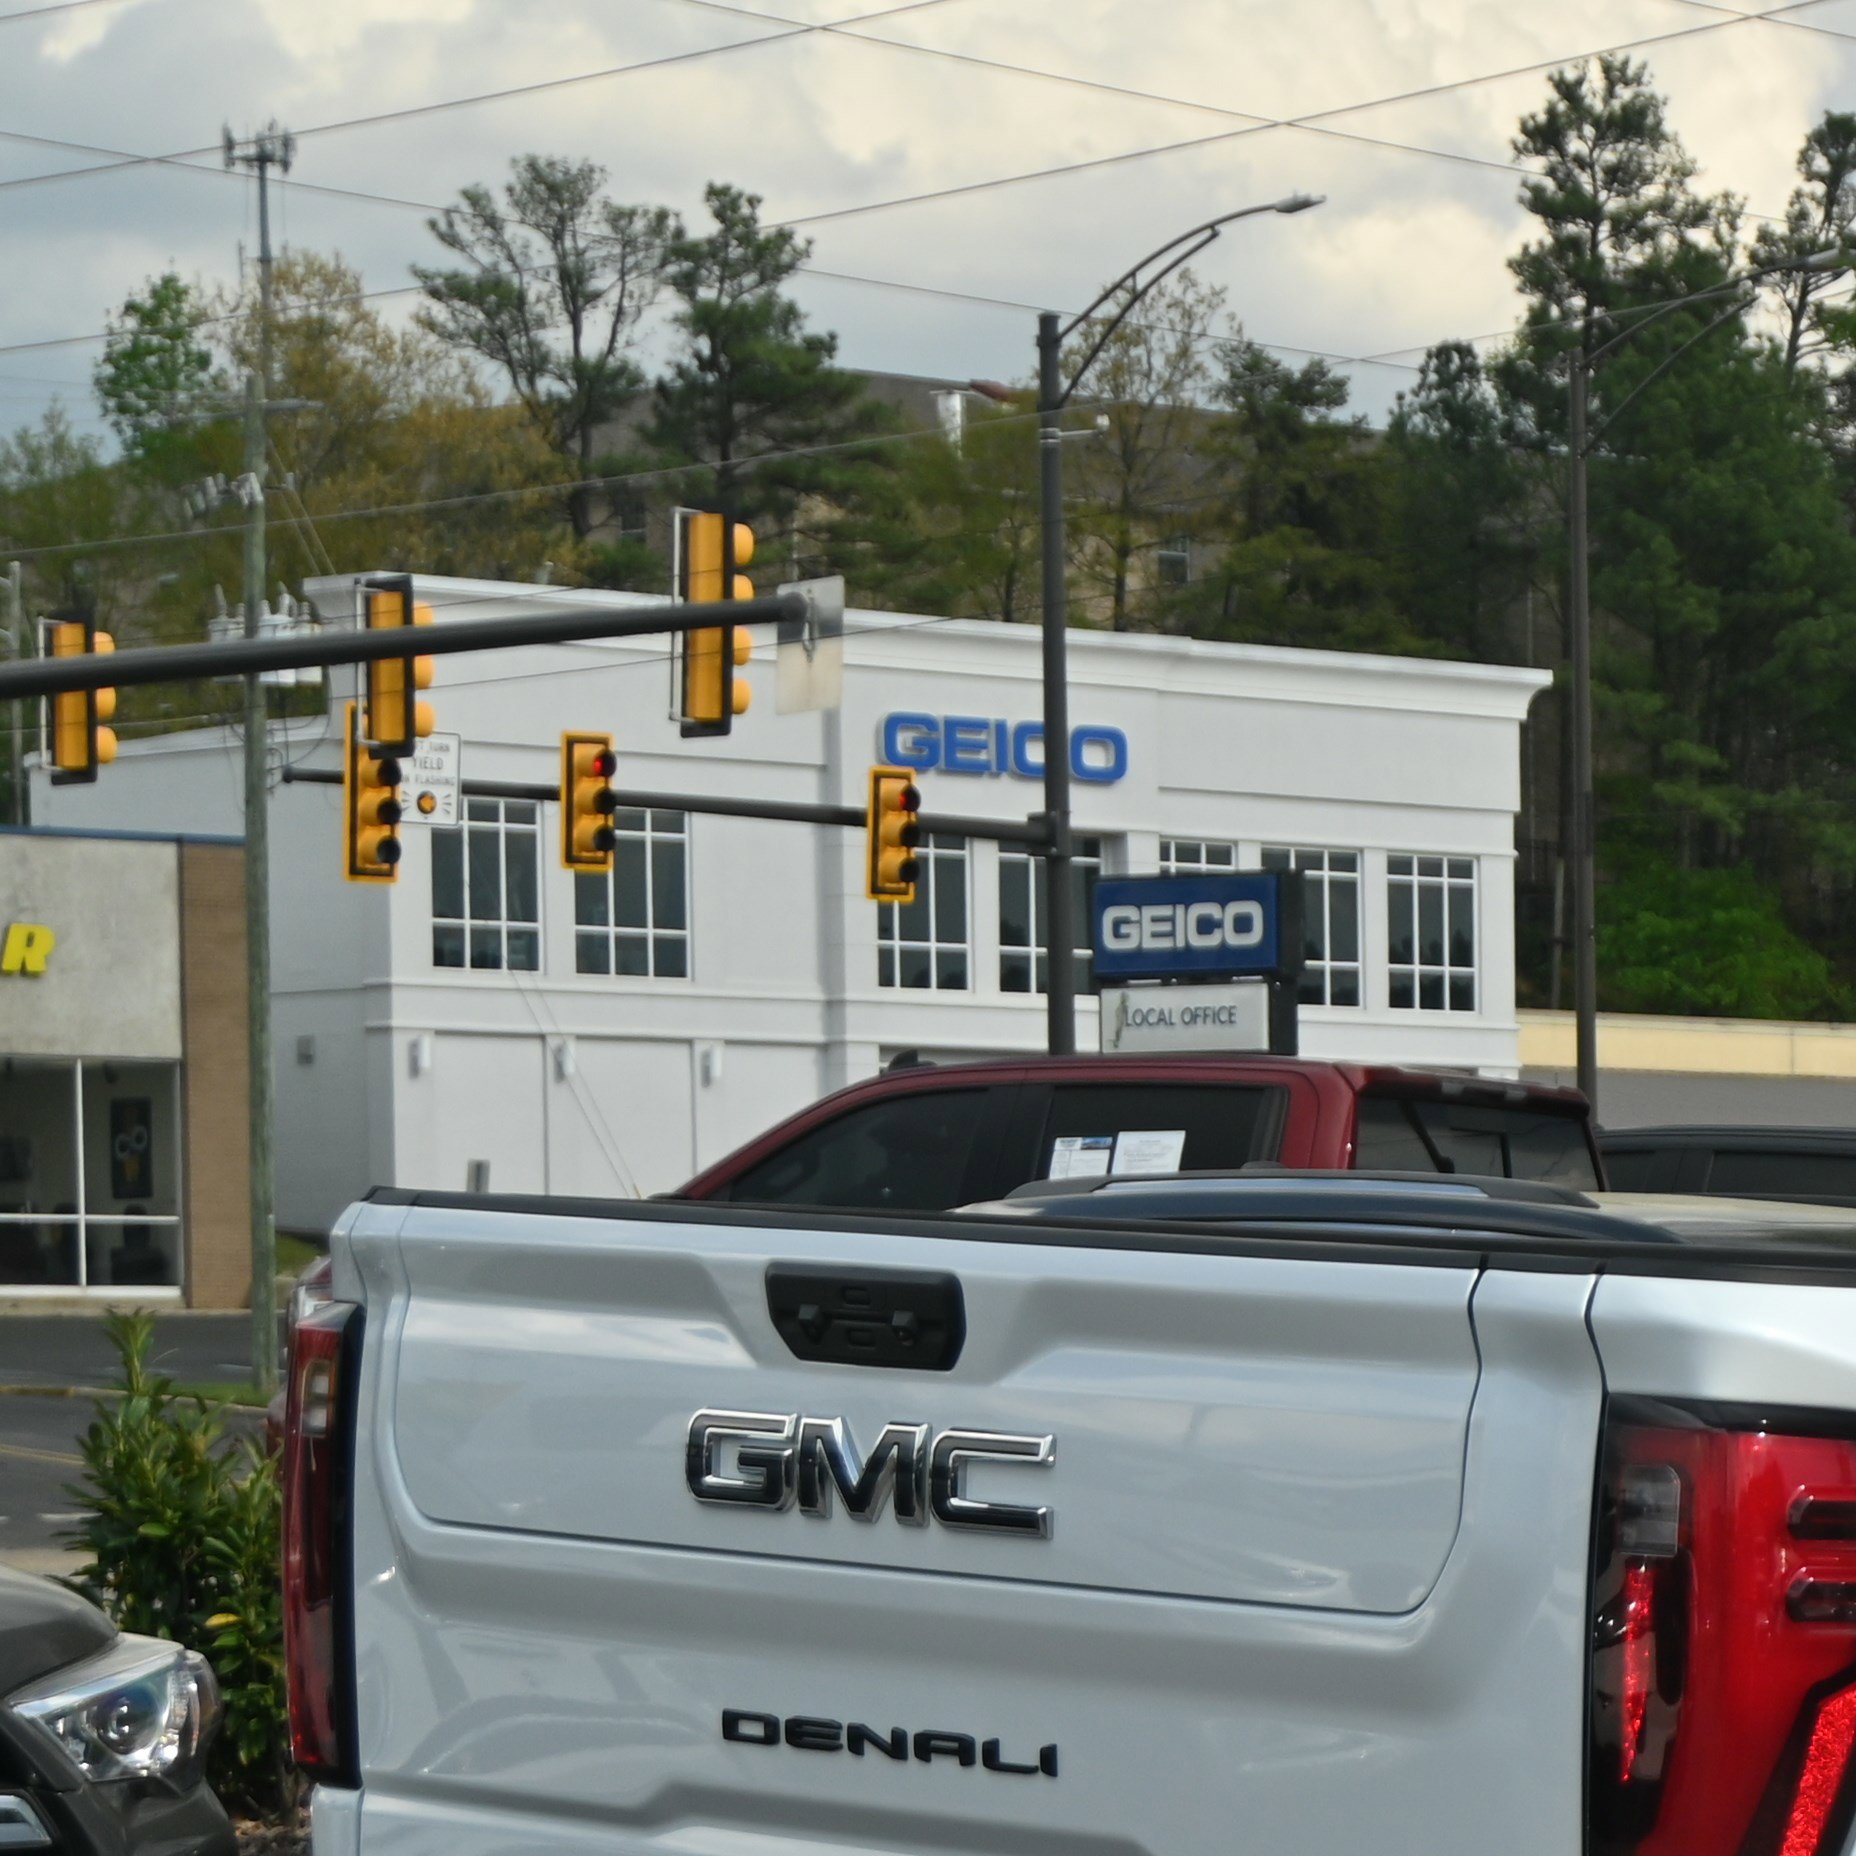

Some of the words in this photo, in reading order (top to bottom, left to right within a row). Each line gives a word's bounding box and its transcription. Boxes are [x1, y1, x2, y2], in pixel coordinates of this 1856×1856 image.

[883, 711, 1128, 781] GEICO
[1103, 900, 1264, 950] GEICO
[1125, 1007, 1175, 1028] LOCAL
[1180, 1005, 1238, 1025] OFFICE
[686, 1407, 1058, 1541] GMC
[721, 1707, 1059, 1778] DENALI
